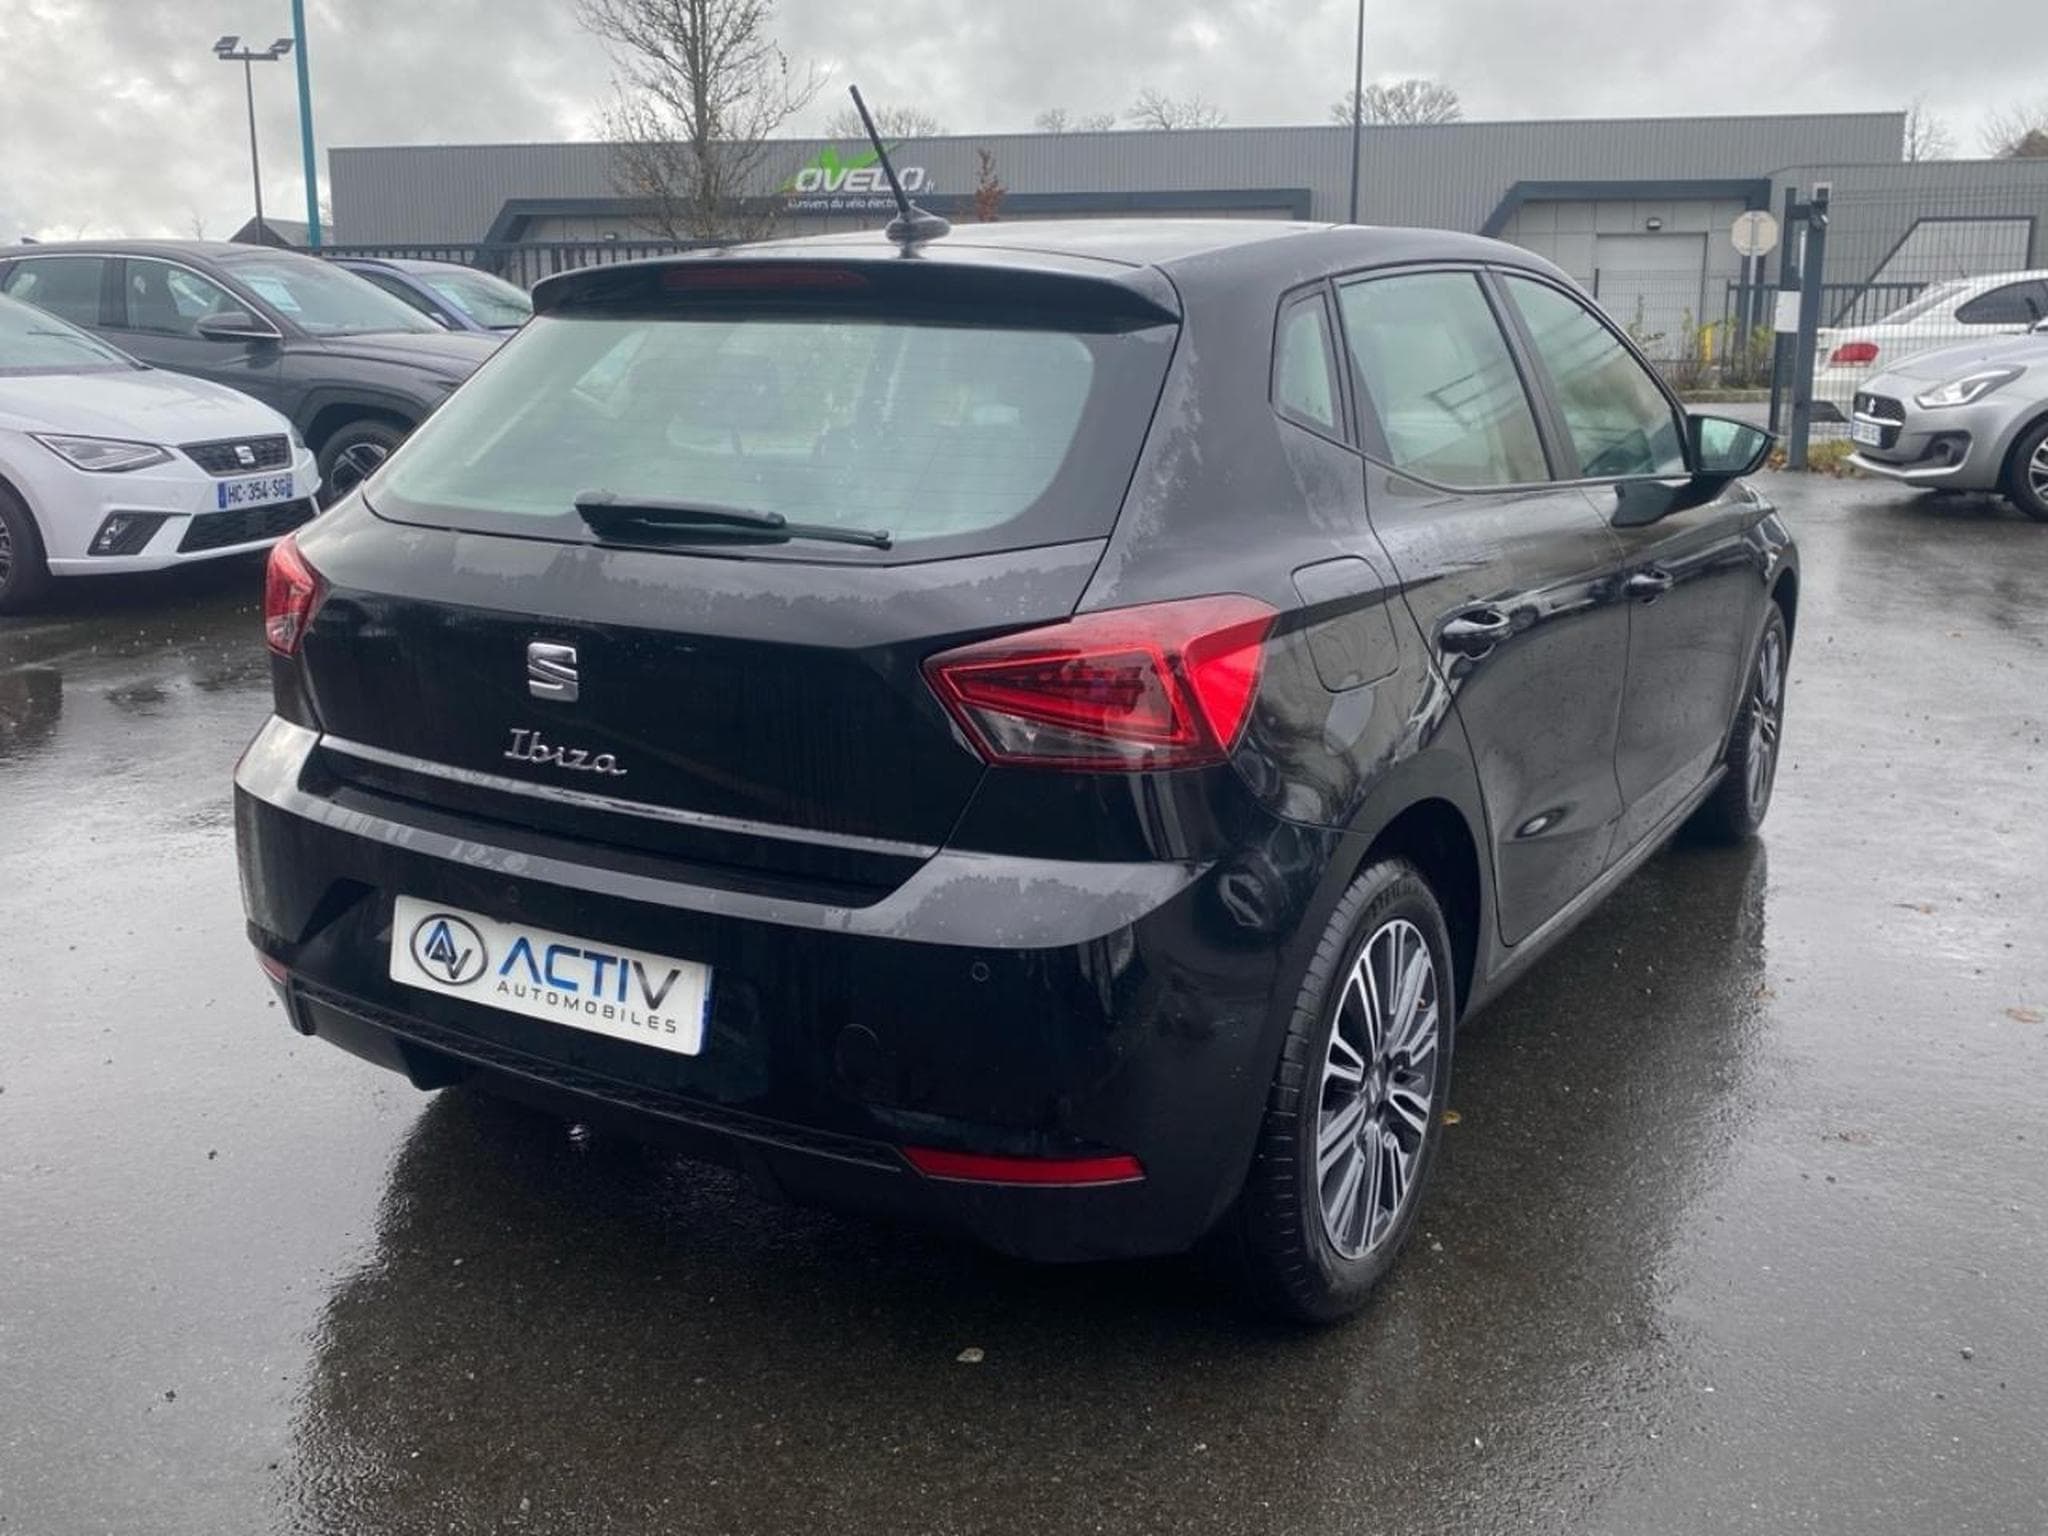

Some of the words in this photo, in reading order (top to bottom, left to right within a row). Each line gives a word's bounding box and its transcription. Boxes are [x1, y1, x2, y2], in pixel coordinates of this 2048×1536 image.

[794, 166, 926, 192] OVELO
[504, 728, 628, 775] Ibiza
[499, 936, 681, 1011] ACTIV
[497, 980, 678, 1034] AUTOMOBILES
